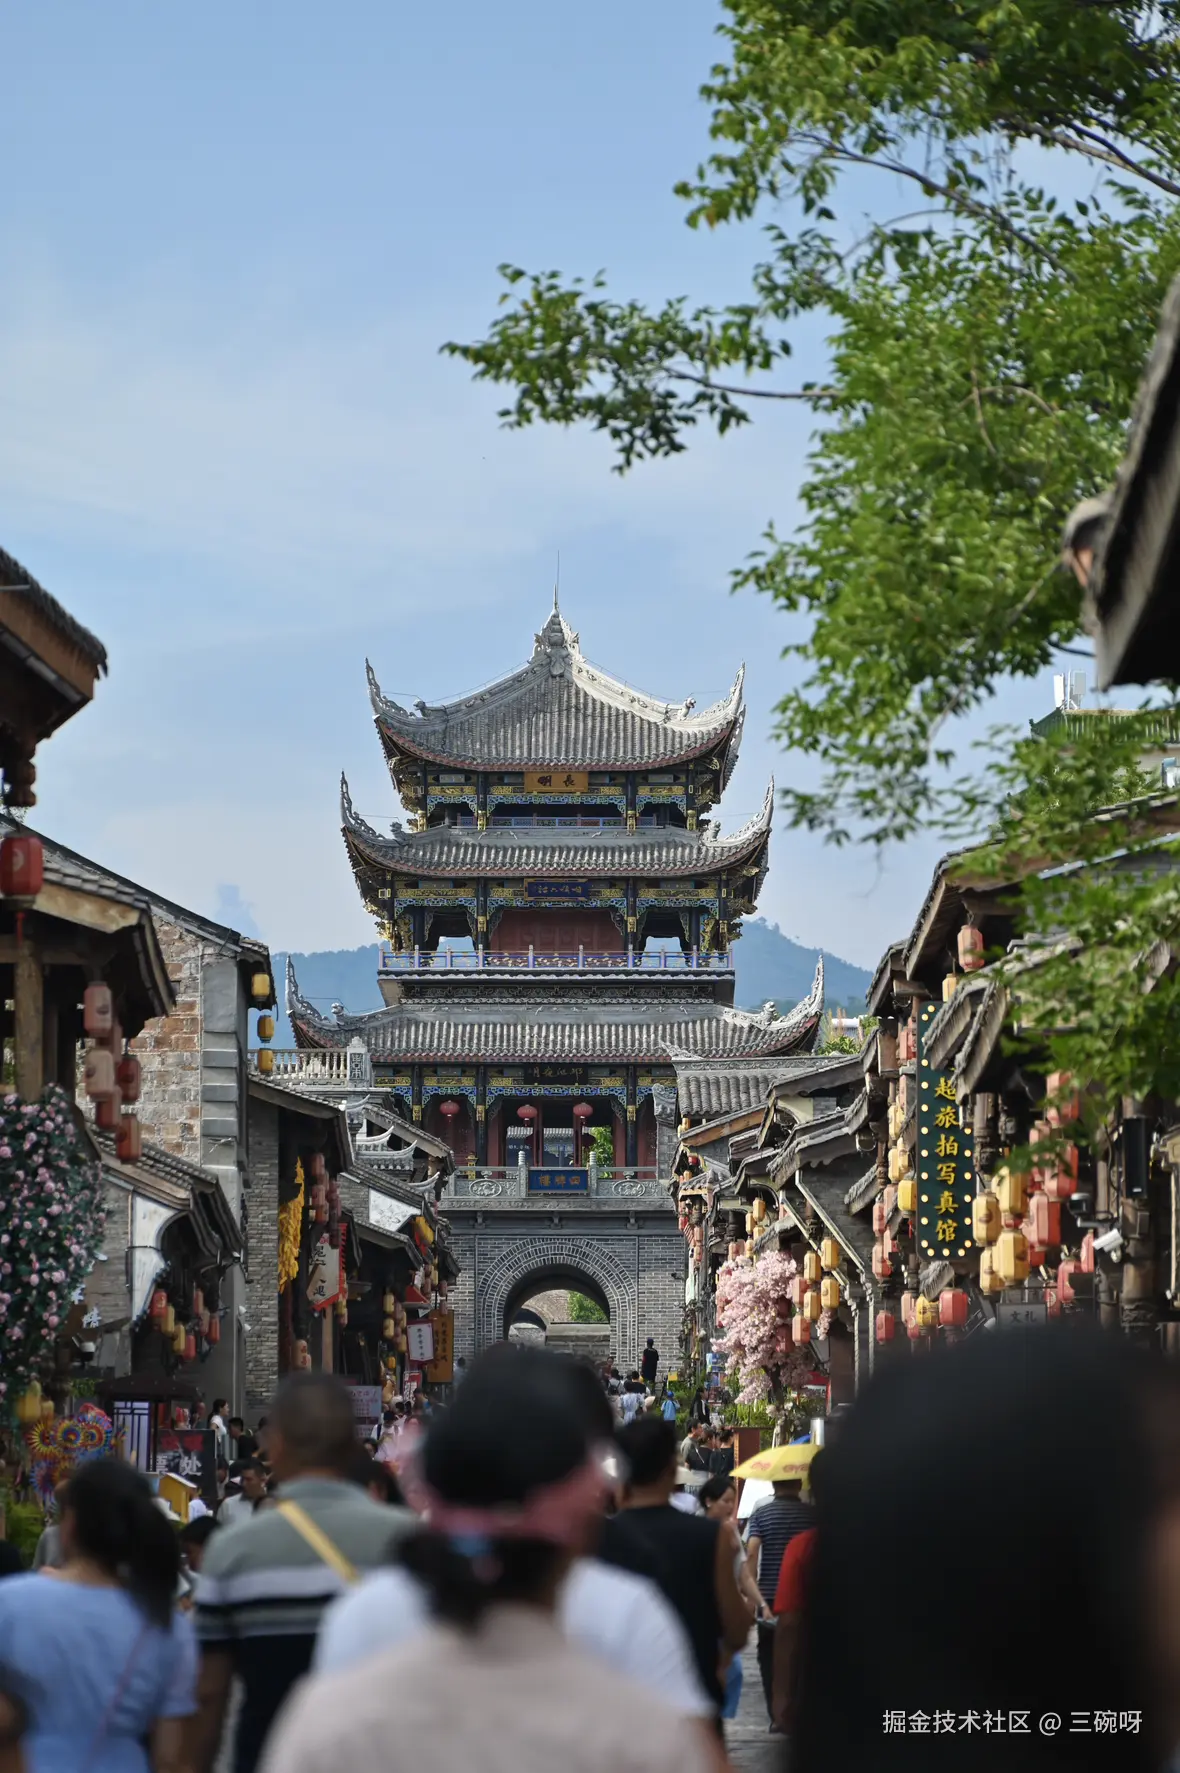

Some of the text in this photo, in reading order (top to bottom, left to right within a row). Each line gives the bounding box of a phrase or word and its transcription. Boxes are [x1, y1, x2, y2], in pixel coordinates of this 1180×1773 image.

[934, 1067, 960, 1243] 超旅拍写真馆
